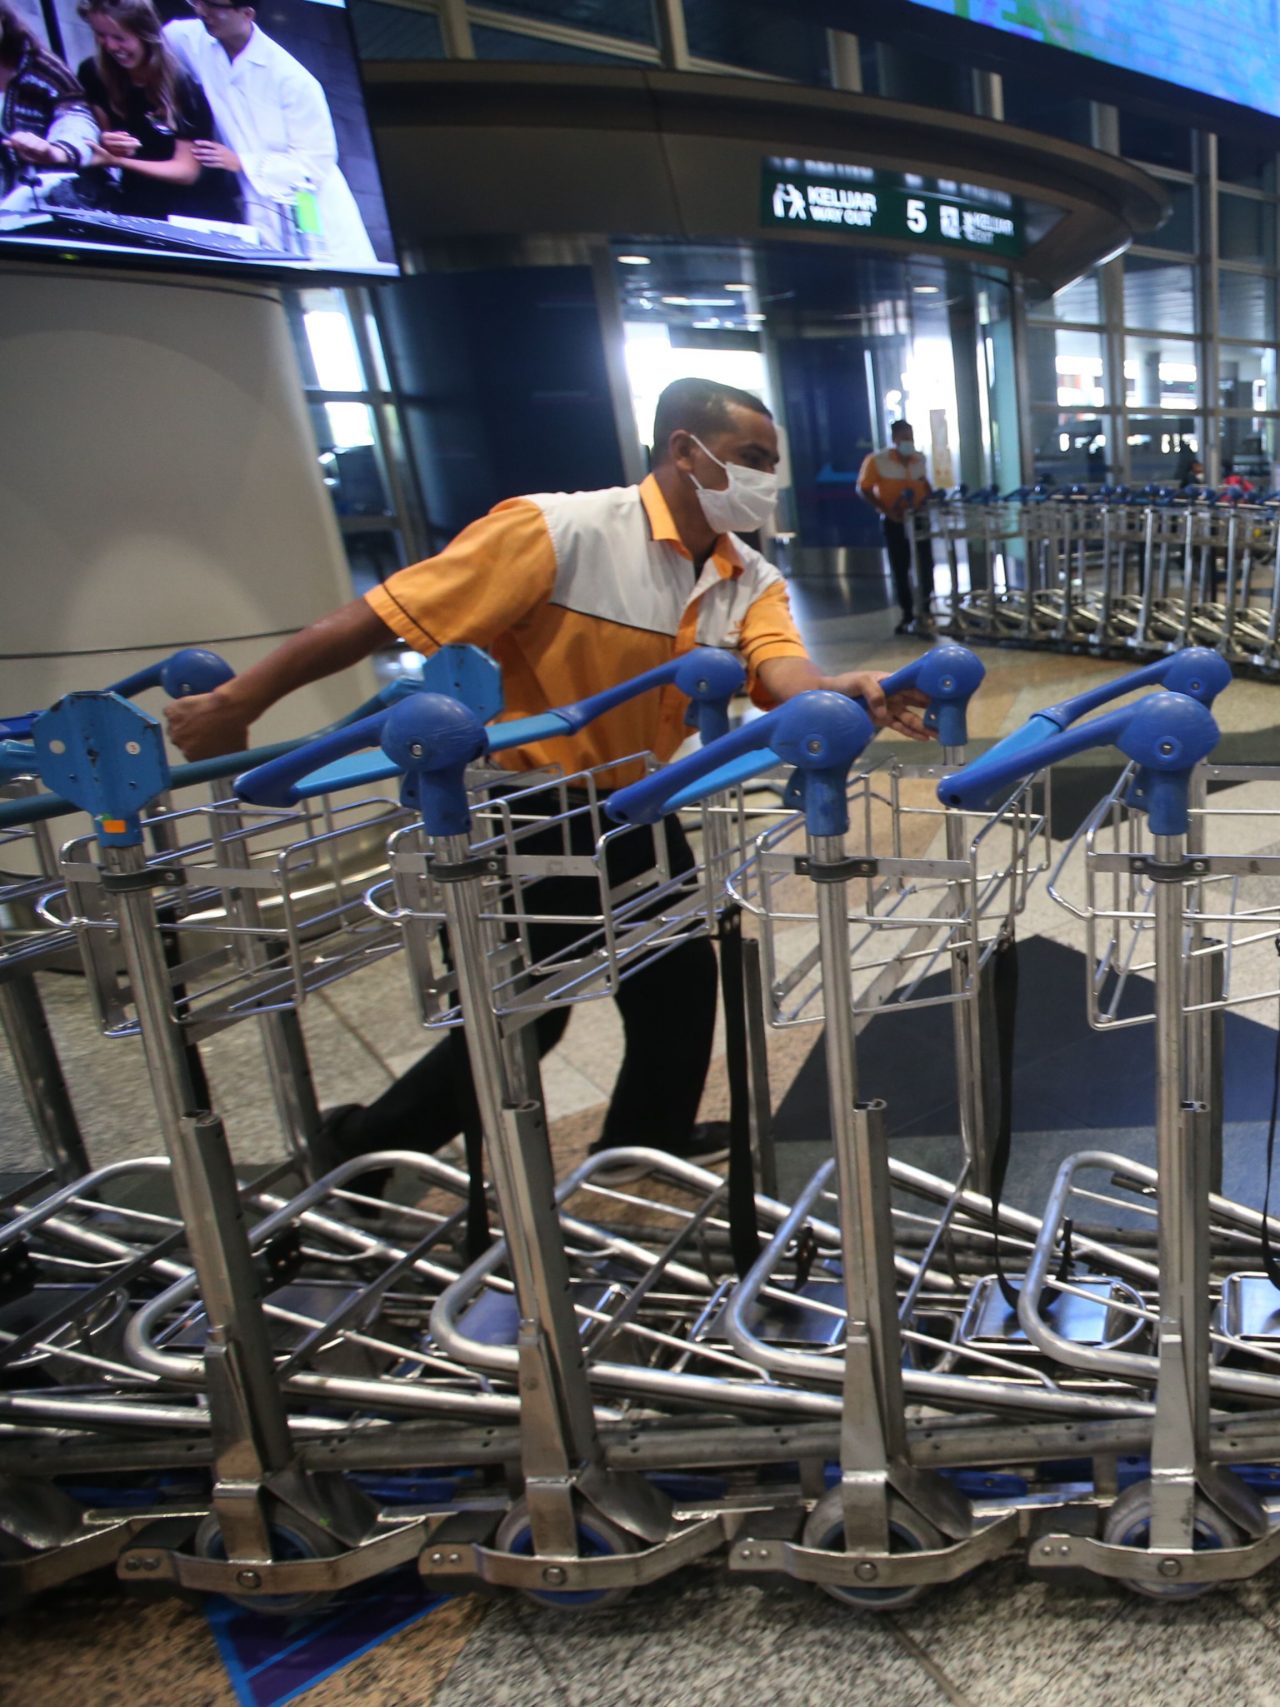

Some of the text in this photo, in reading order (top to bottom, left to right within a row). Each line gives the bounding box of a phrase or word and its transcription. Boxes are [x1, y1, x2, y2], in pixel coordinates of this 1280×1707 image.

[807, 185, 877, 213] KELUAR
[809, 205, 873, 227] WAY OUT
[906, 198, 928, 234] 5
